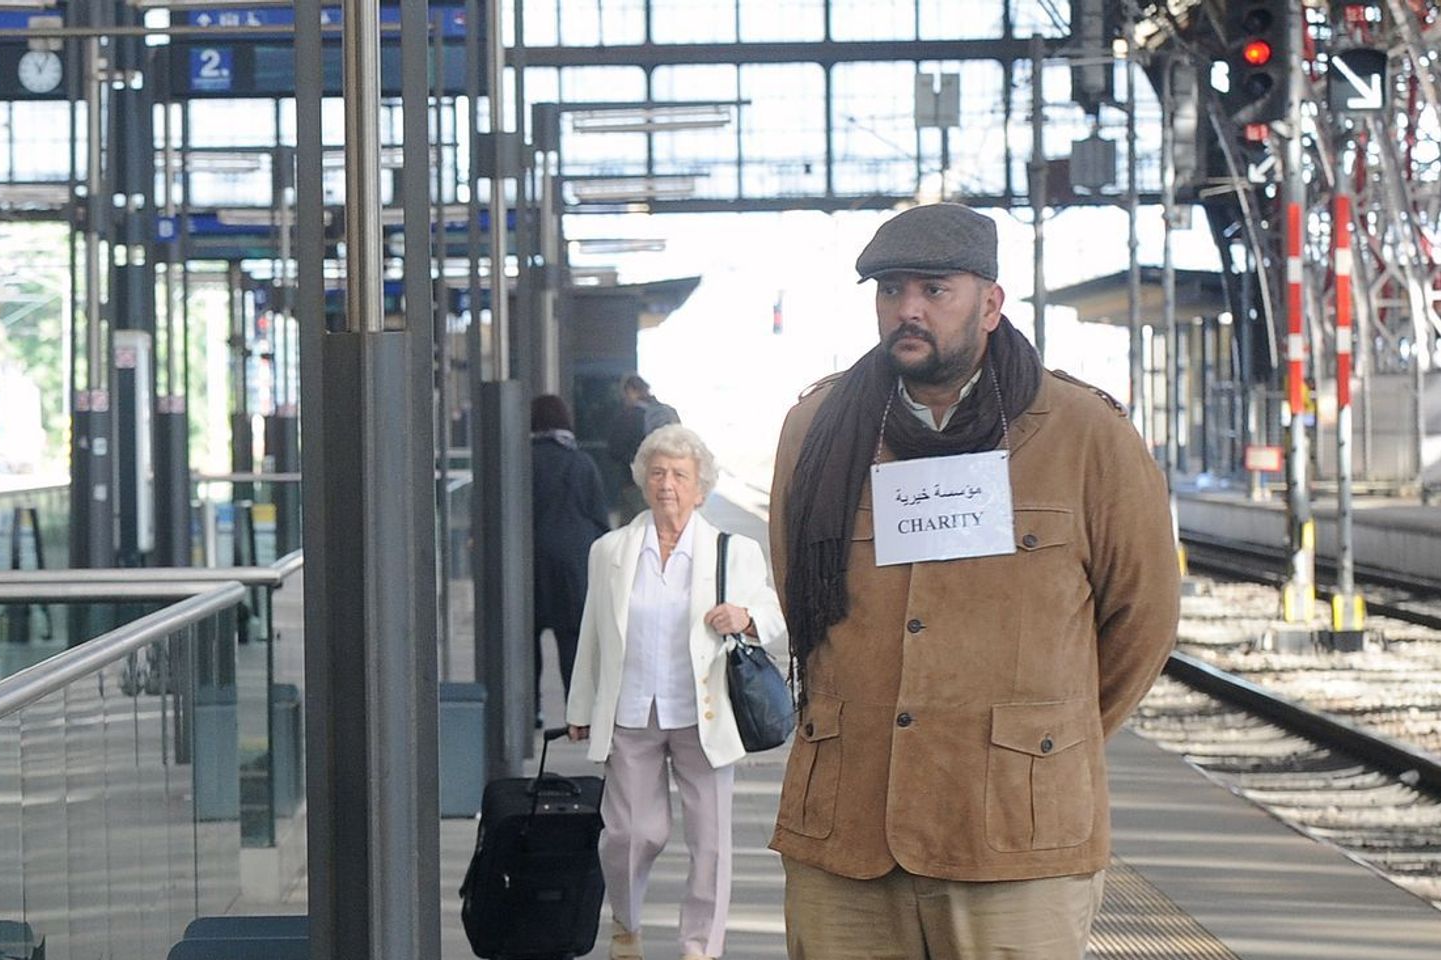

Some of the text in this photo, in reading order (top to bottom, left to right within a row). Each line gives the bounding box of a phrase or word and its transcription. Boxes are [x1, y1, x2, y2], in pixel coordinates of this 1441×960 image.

[896, 484, 982, 506] مؤسسة خيرية
[898, 512, 984, 534] CHARITY
